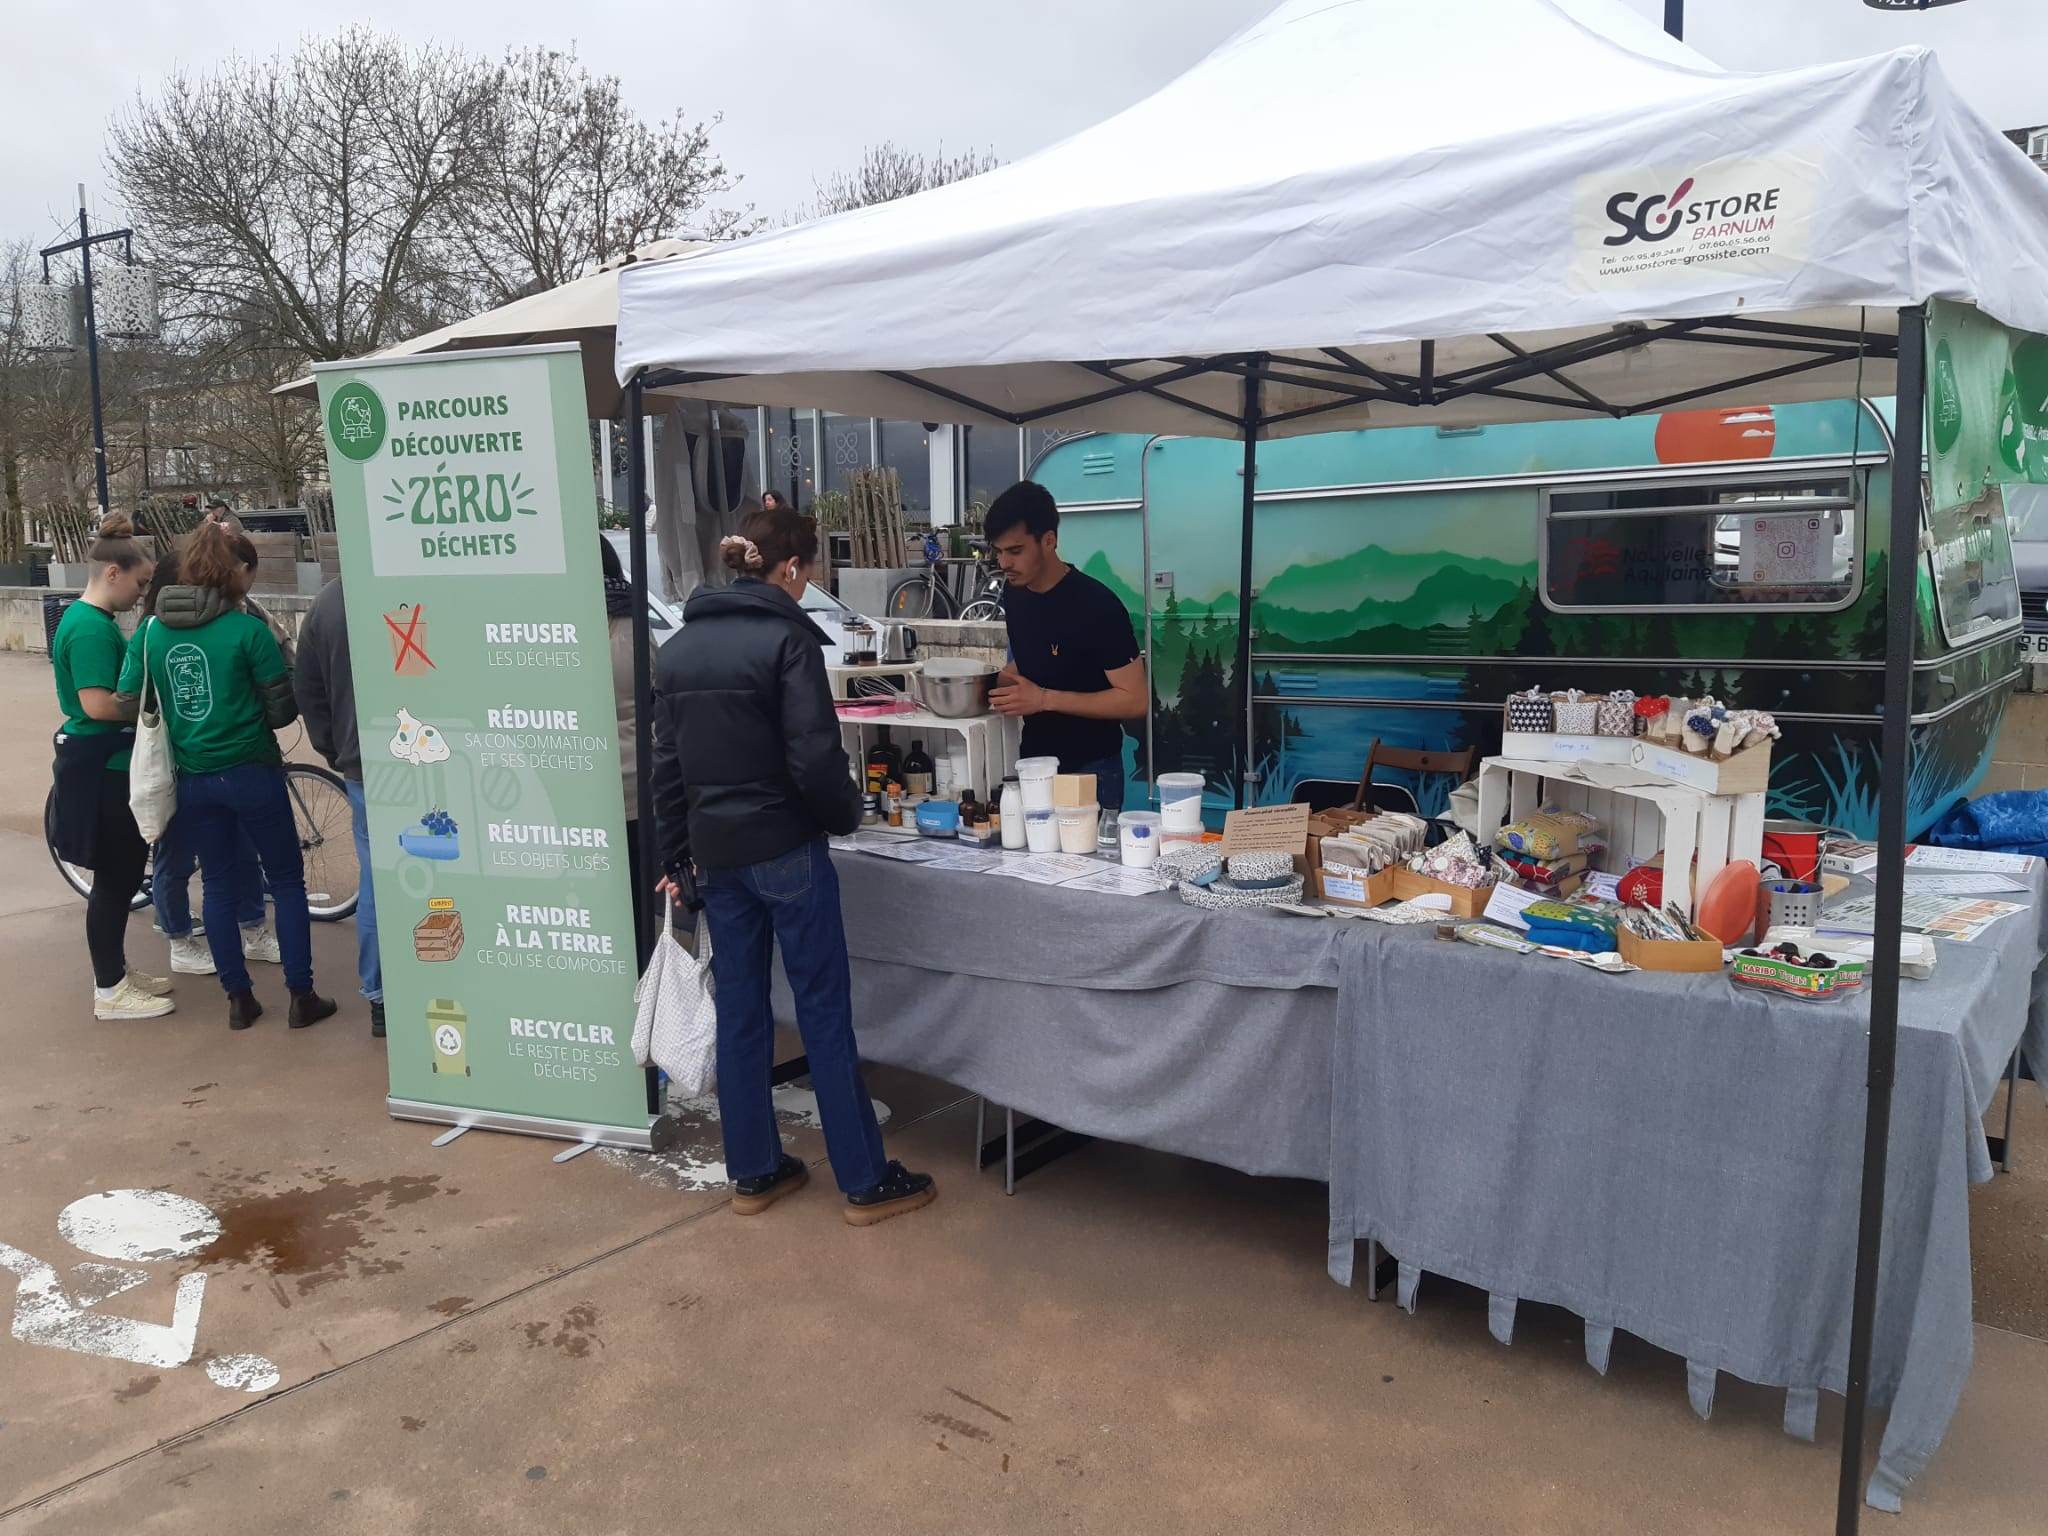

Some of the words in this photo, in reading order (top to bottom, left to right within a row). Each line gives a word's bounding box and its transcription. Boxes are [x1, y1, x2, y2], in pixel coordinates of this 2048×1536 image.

[1686, 188, 1780, 224] STORE
[1692, 215, 1775, 240] BARNUM
[1600, 246, 1770, 276] www.sostore-grossiste.com
[397, 395, 509, 421] PARCOURS
[391, 431, 523, 457] DÉCOUVERTE
[409, 461, 512, 525] ZÉRO
[421, 531, 517, 558] DÉCHETS
[485, 623, 579, 644] REFUSER
[487, 651, 513, 666] LES
[517, 648, 581, 667] DÉCHETS
[487, 704, 579, 730] RÉDUIRE
[464, 733, 481, 747] SA
[485, 734, 608, 751] CONSOMMATION
[480, 753, 496, 767] ET
[501, 753, 525, 768] SES
[529, 751, 594, 771] DÉCHETS
[488, 819, 609, 848] RÉUTILISER
[493, 851, 518, 866] LES
[521, 853, 570, 870] OBJETS
[573, 852, 610, 871] USÉS
[506, 905, 592, 928] RENDRE
[495, 923, 511, 947] À
[516, 930, 543, 950] LA
[547, 931, 613, 955] TERRE
[477, 949, 494, 964] CE
[498, 951, 523, 969] QUI
[527, 954, 543, 969] SE
[547, 955, 627, 975] COMPOSTE
[1743, 964, 1776, 976] HARIBO
[510, 1017, 615, 1045] RECYCLER
[508, 1042, 523, 1057] LE
[528, 1044, 569, 1062] RESTE
[572, 1047, 591, 1063] DE
[595, 1050, 620, 1066] SES
[534, 1062, 597, 1082] DÉCHETS
